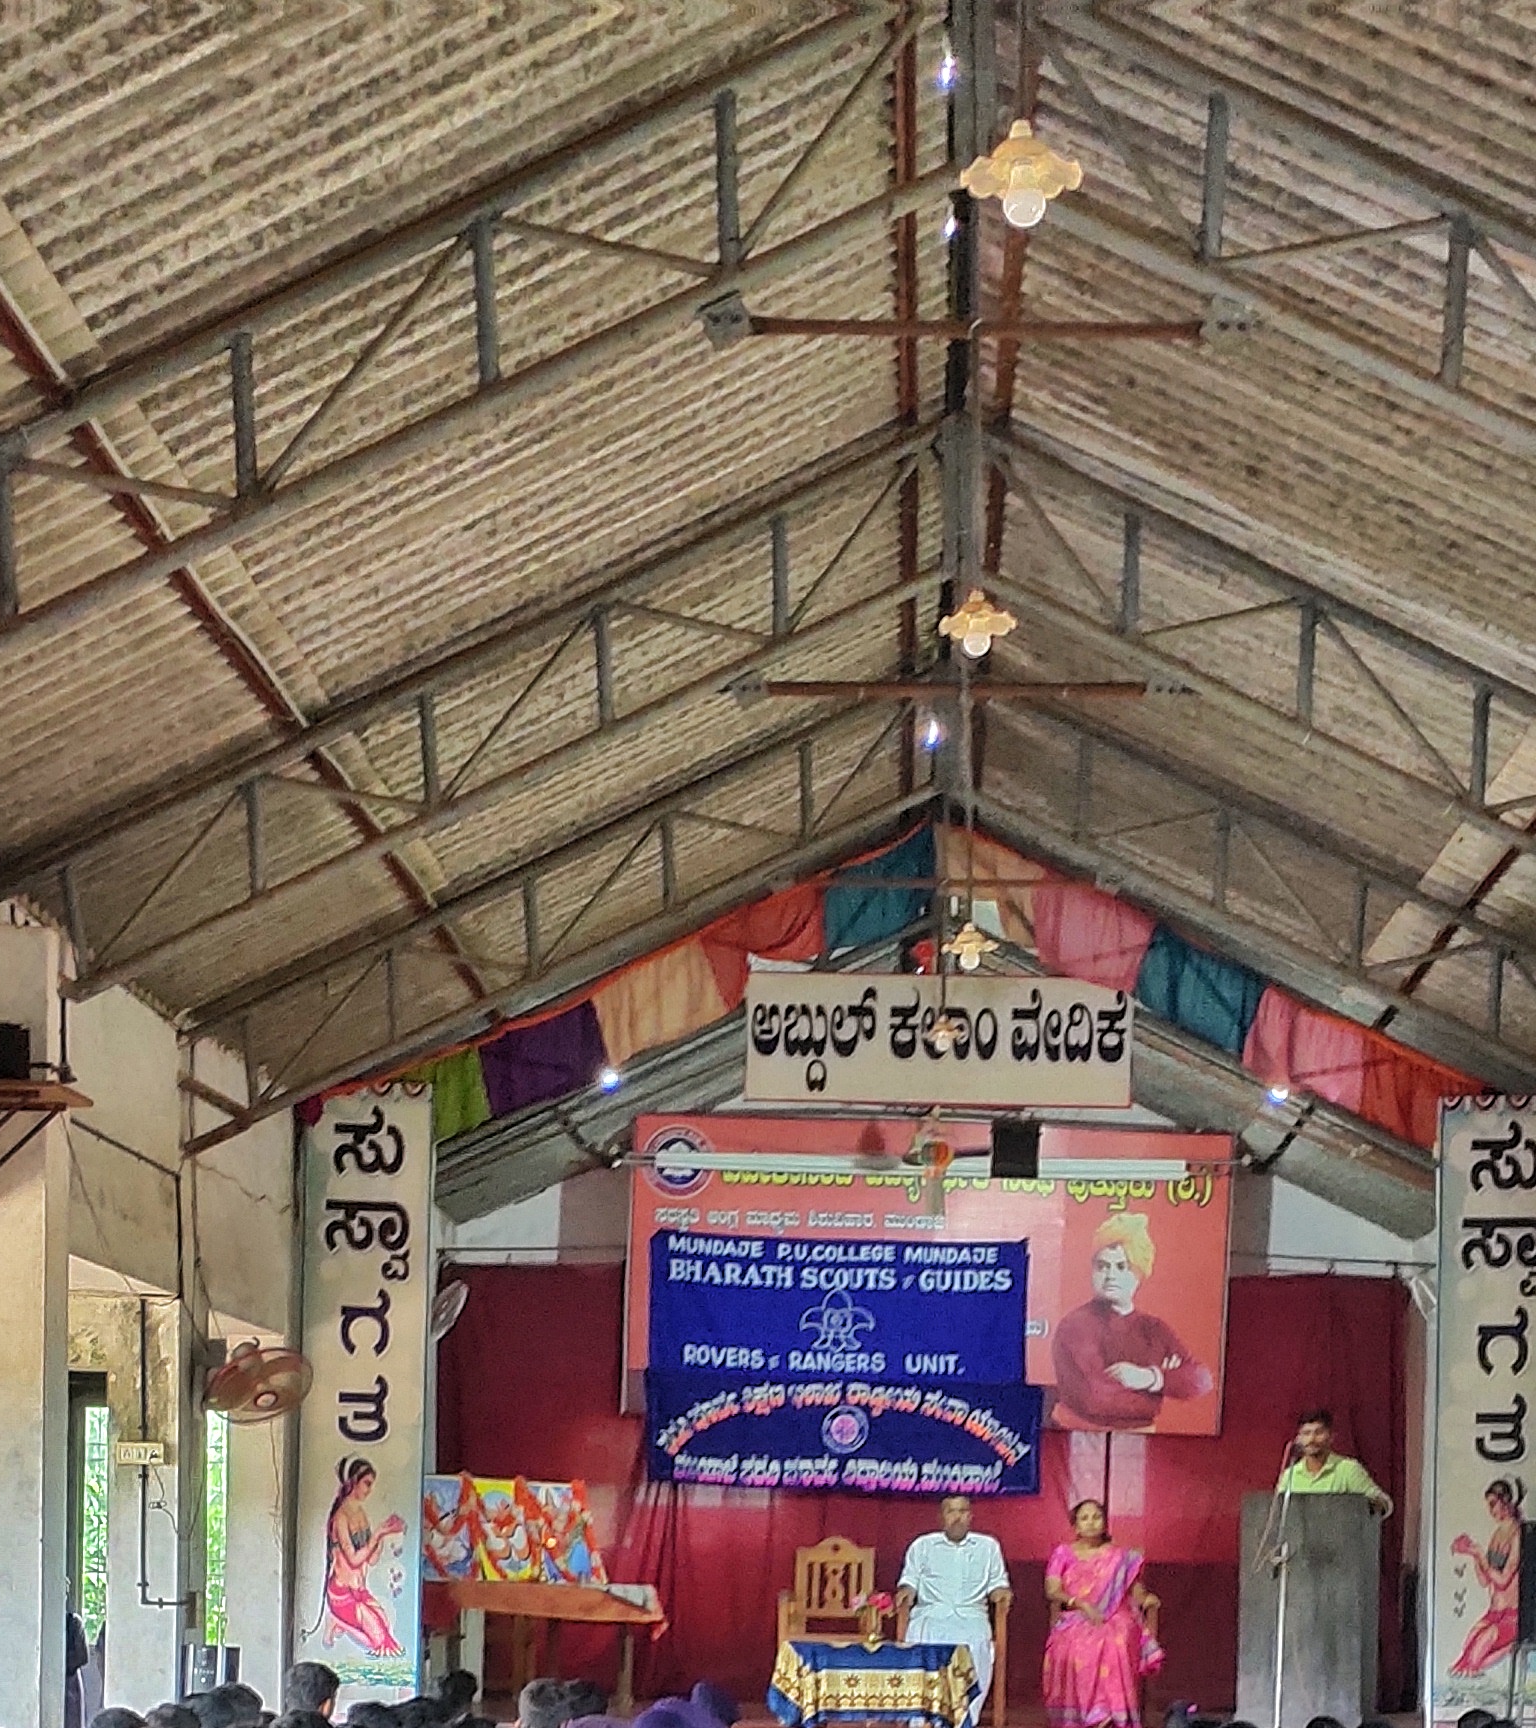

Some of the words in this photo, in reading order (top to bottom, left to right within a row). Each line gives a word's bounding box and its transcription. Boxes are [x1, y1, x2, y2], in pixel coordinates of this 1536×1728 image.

[752, 987, 876, 1092] ಅಬ್ದುಲ್
[1010, 988, 1127, 1062] ವೇದಿಕೆ
[668, 1234, 764, 1258] MUNDAJE
[903, 1246, 999, 1265] MUNDAJE
[325, 1105, 411, 1442] ಸುಸ್ವಾಗತ
[667, 1258, 795, 1289] BHARATH
[800, 1266, 897, 1291] SCOUTS
[918, 1269, 1013, 1292] GUIDES
[683, 1343, 765, 1369] ROVERS
[787, 1350, 887, 1373] RANGERS
[904, 1353, 966, 1375] UNIT.
